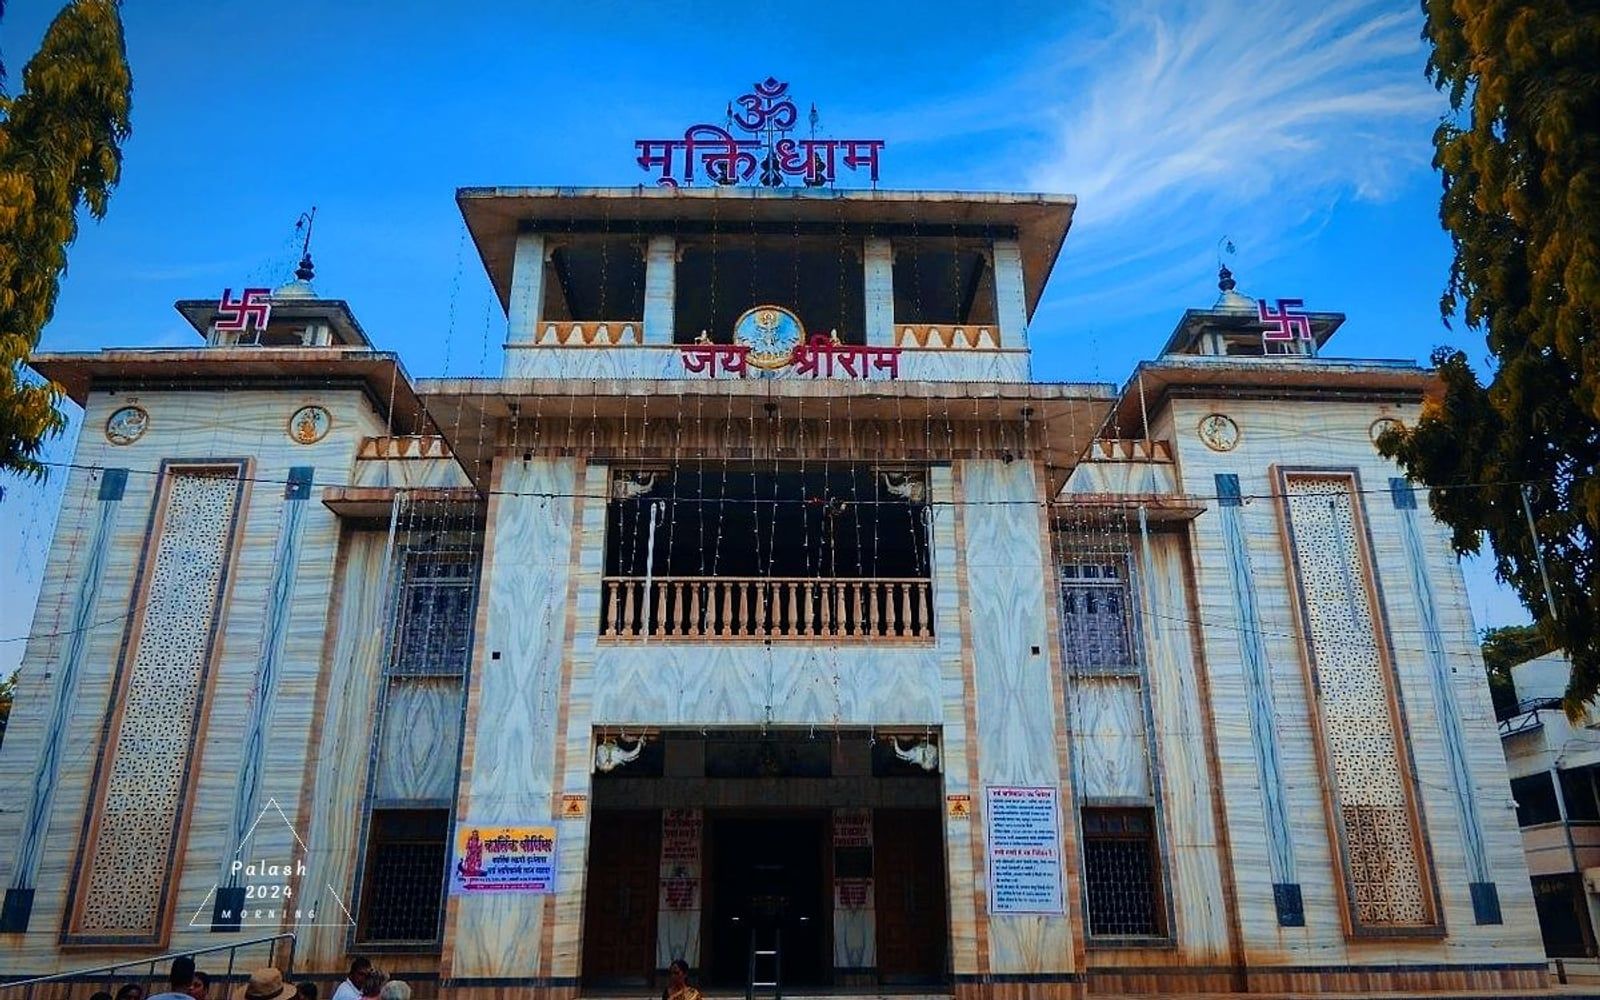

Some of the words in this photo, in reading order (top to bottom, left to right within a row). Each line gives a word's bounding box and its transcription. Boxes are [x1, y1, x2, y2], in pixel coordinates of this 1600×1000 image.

[635, 124, 761, 187] मुक्ति
[776, 138, 885, 182] धाम
[679, 345, 750, 379] जय
